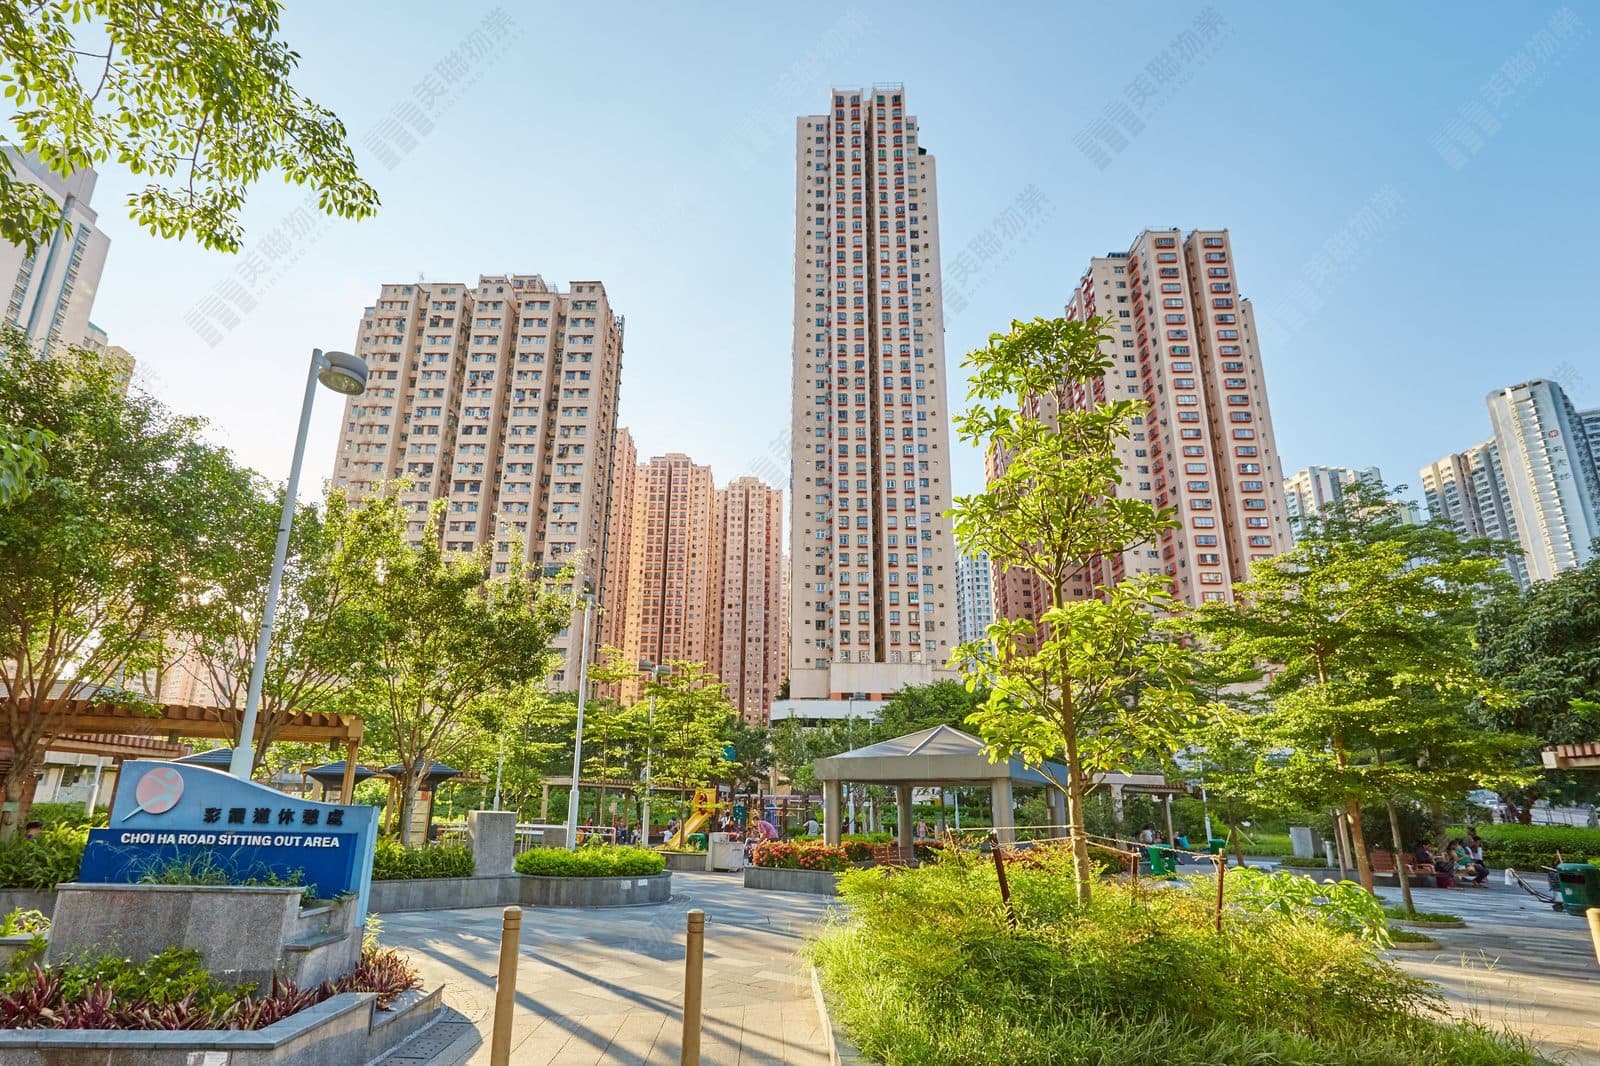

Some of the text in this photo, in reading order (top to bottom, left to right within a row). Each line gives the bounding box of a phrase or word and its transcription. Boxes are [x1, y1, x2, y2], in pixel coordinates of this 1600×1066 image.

[120, 833, 340, 848] CHOI HA ROAD SITTING OUT AREA
